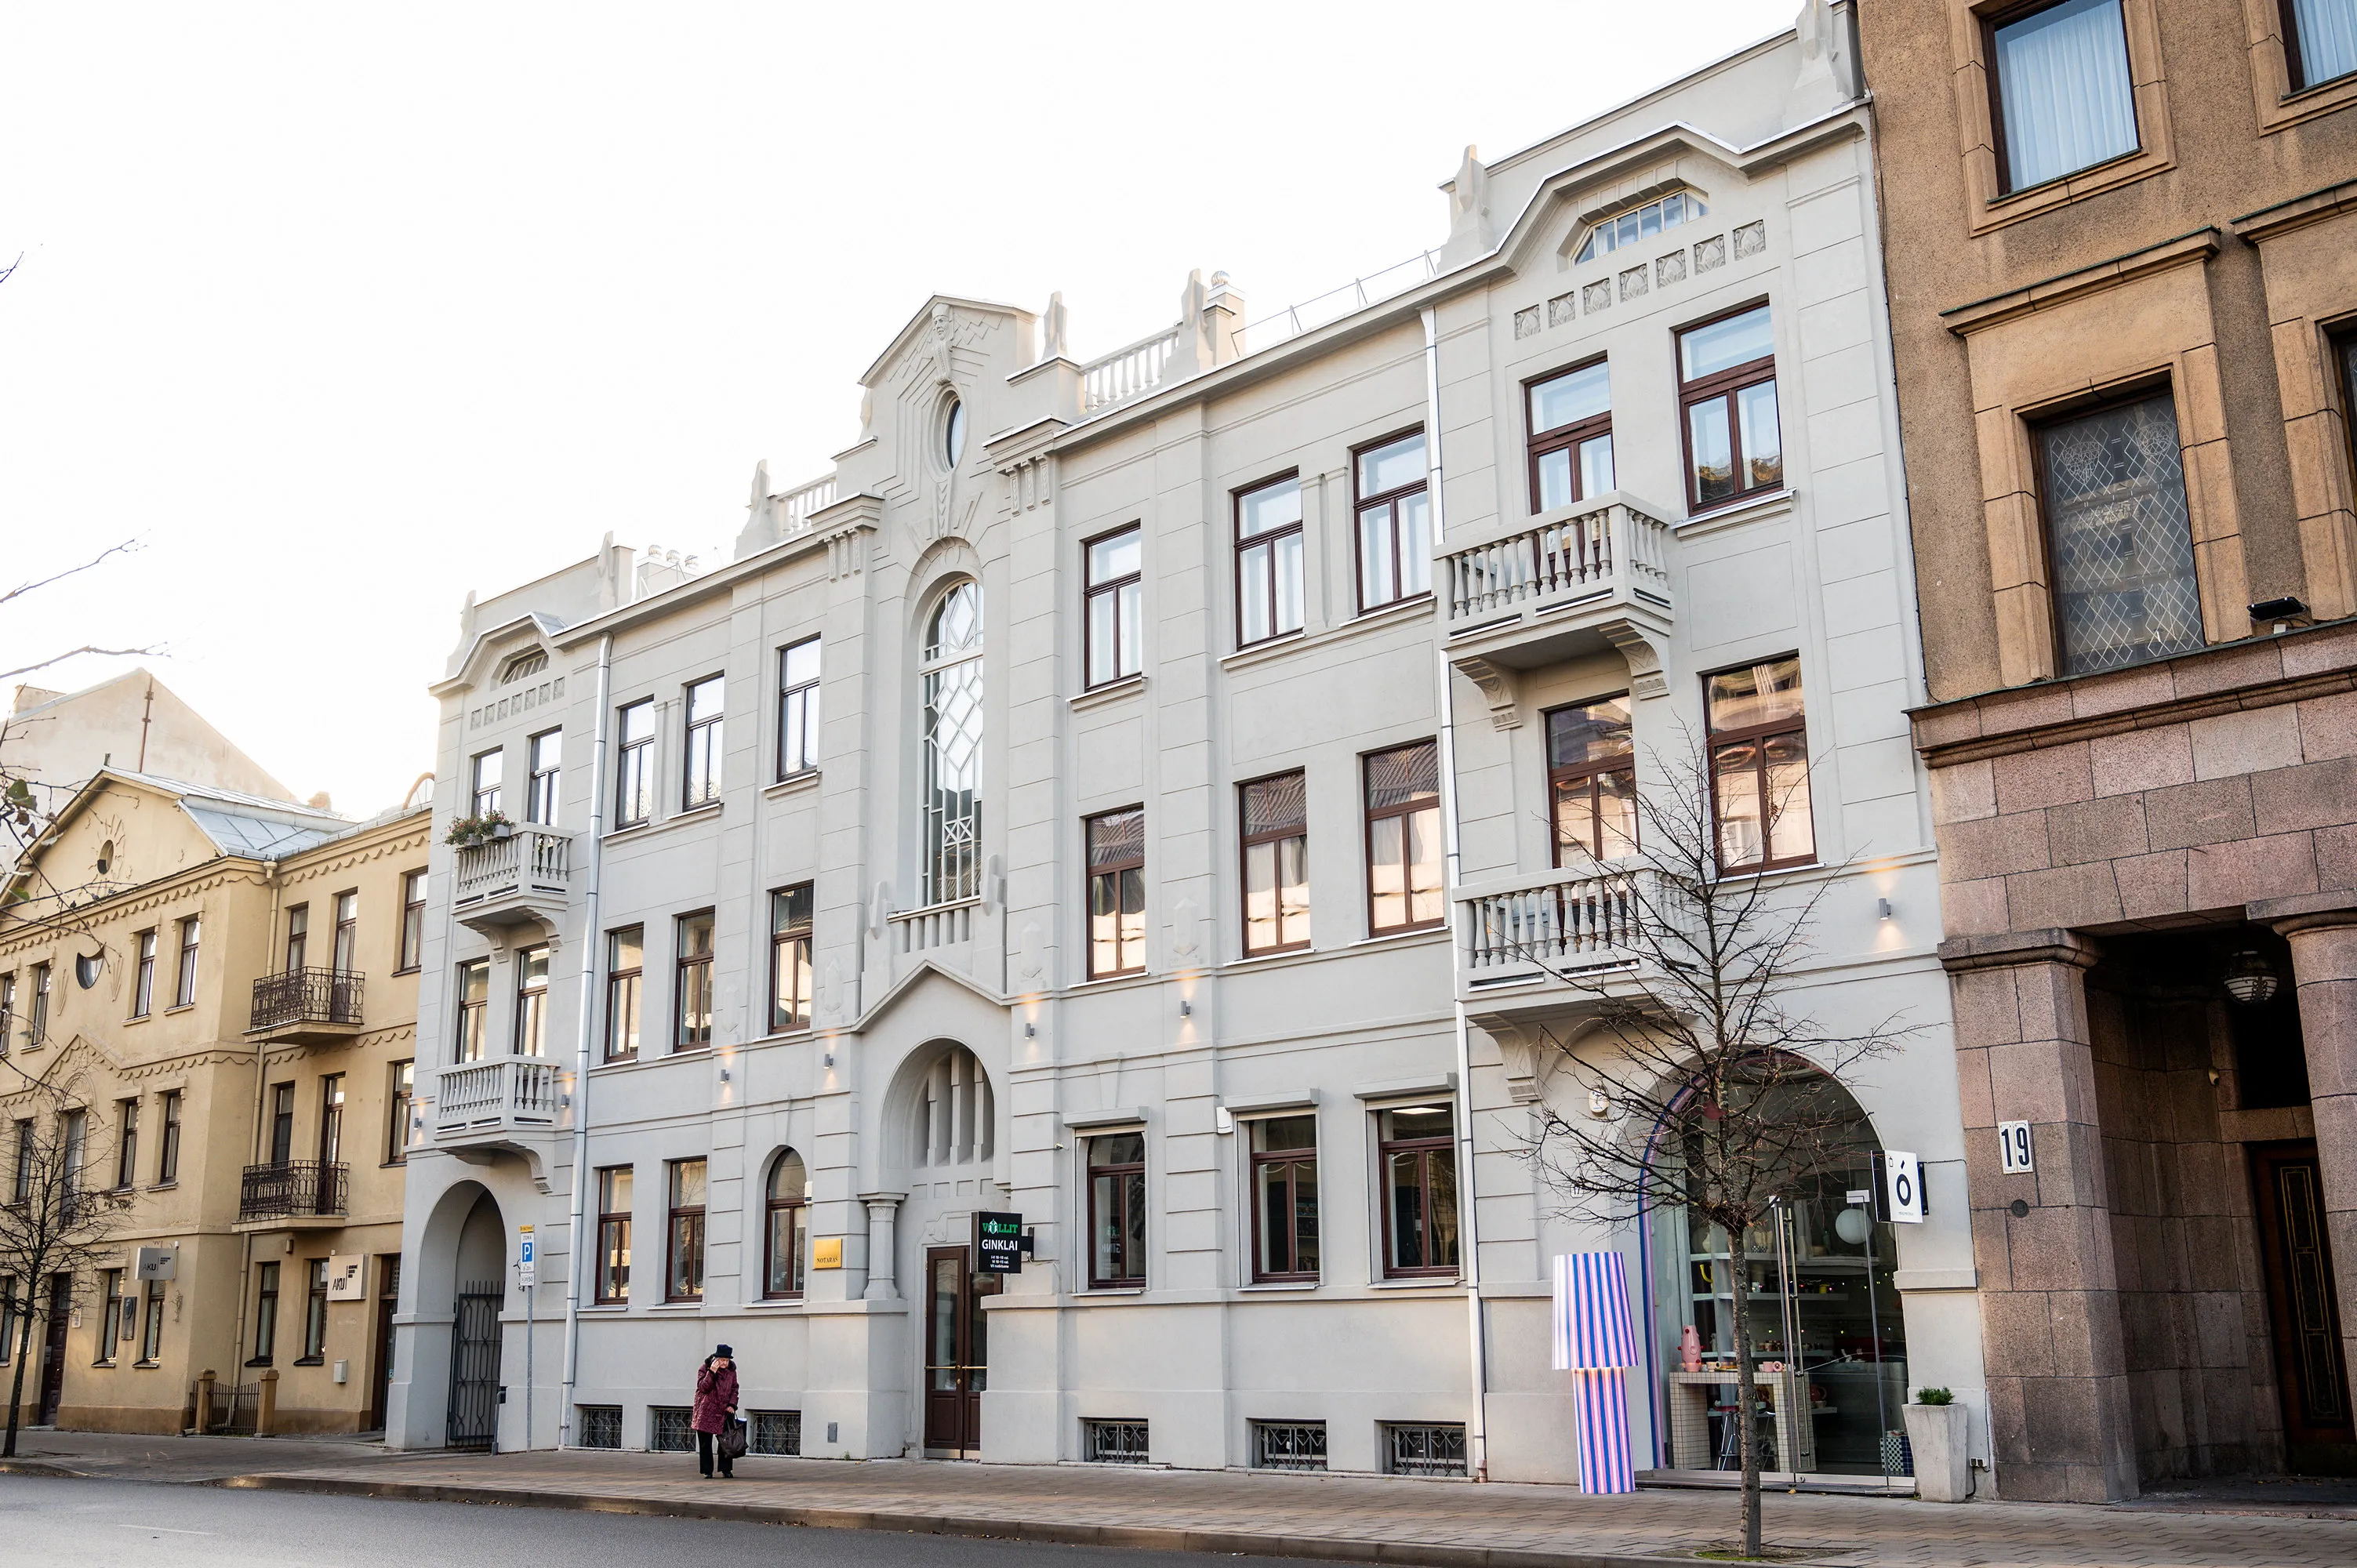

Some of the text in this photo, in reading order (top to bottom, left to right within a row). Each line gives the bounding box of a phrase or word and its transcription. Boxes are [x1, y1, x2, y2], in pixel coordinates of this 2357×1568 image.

[2001, 1127, 2029, 1167] 19
[982, 1240, 1018, 1250] GINKLAI
[332, 1278, 345, 1290] AKU
